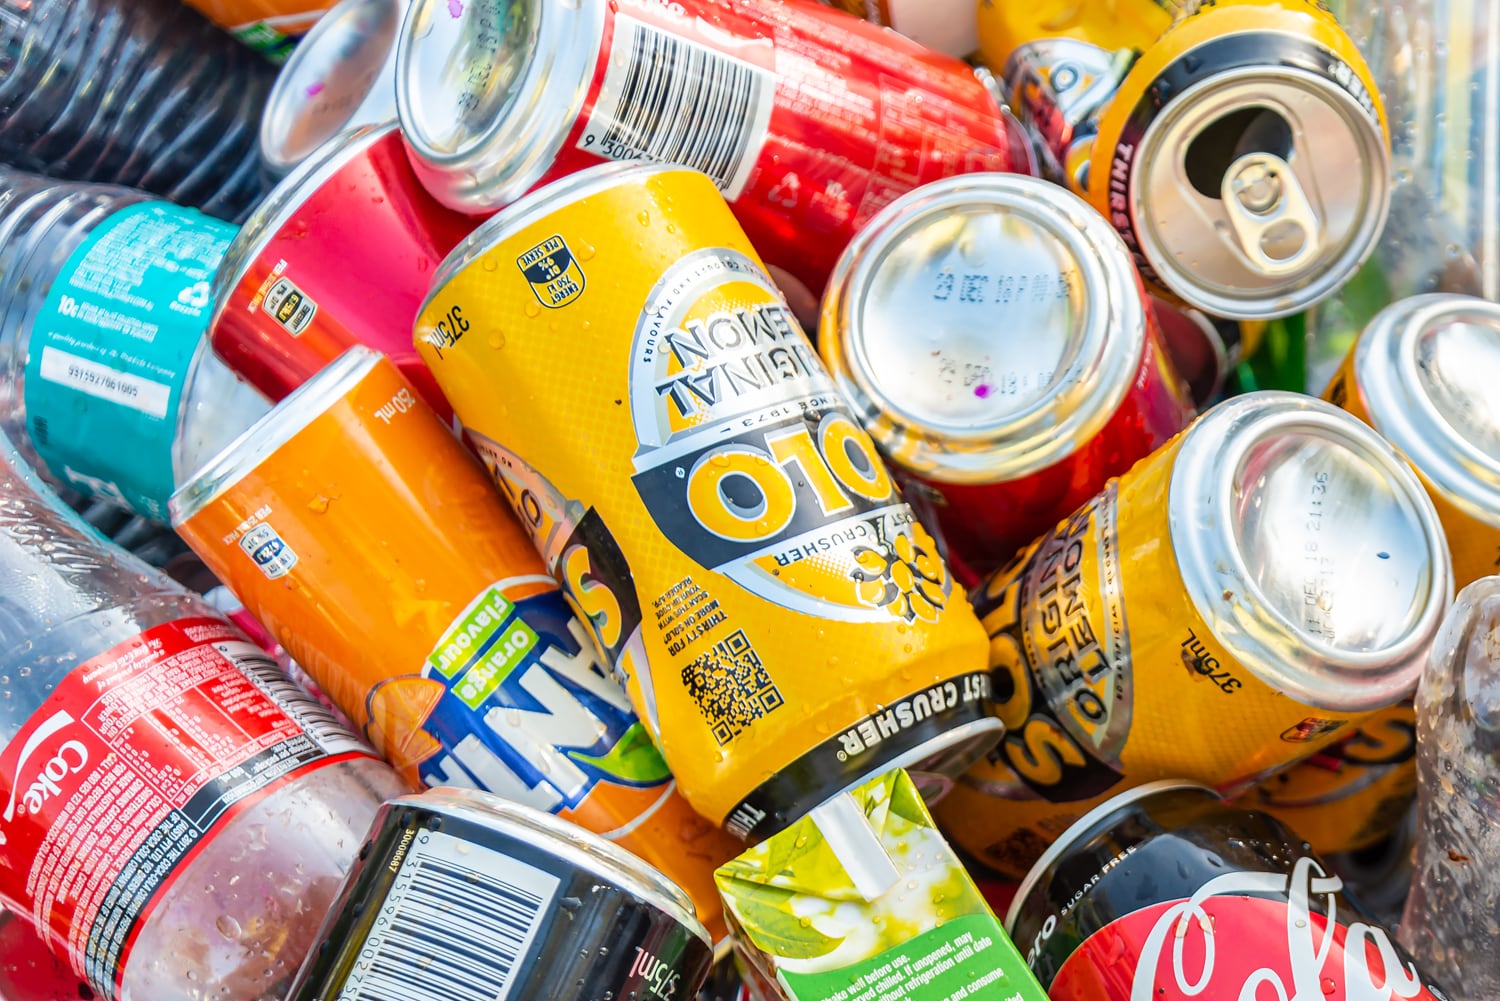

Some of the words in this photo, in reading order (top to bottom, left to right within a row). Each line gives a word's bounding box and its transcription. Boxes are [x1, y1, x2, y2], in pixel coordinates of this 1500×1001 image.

[582, 132, 596, 149] 9
[519, 245, 542, 263] SERVE
[541, 236, 558, 251] PER
[551, 283, 578, 304] ENERGY
[771, 522, 867, 568] CRUSHER
[685, 609, 727, 644] THIRSTY
[694, 597, 719, 620] MORE
[434, 592, 510, 674] Flavour
[667, 637, 686, 657] FOR
[457, 625, 532, 704] Orange
[1180, 627, 1244, 696] 375mL
[846, 674, 960, 758] CRUSHER
[18, 734, 93, 816] Coke
[375, 857, 418, 928] 315596
[1058, 872, 1101, 916] SUGAR
[1099, 842, 1138, 875] FREE
[845, 976, 867, 995] well
[863, 961, 893, 984] before
[889, 950, 911, 969] use.
[874, 969, 906, 994] chilled.
[903, 964, 913, 976] If
[910, 940, 954, 972] unopened,
[952, 929, 972, 947] may
[903, 955, 955, 993] refrigeration
[951, 944, 974, 963] until
[970, 932, 993, 952] date
[965, 964, 1004, 994] consume
